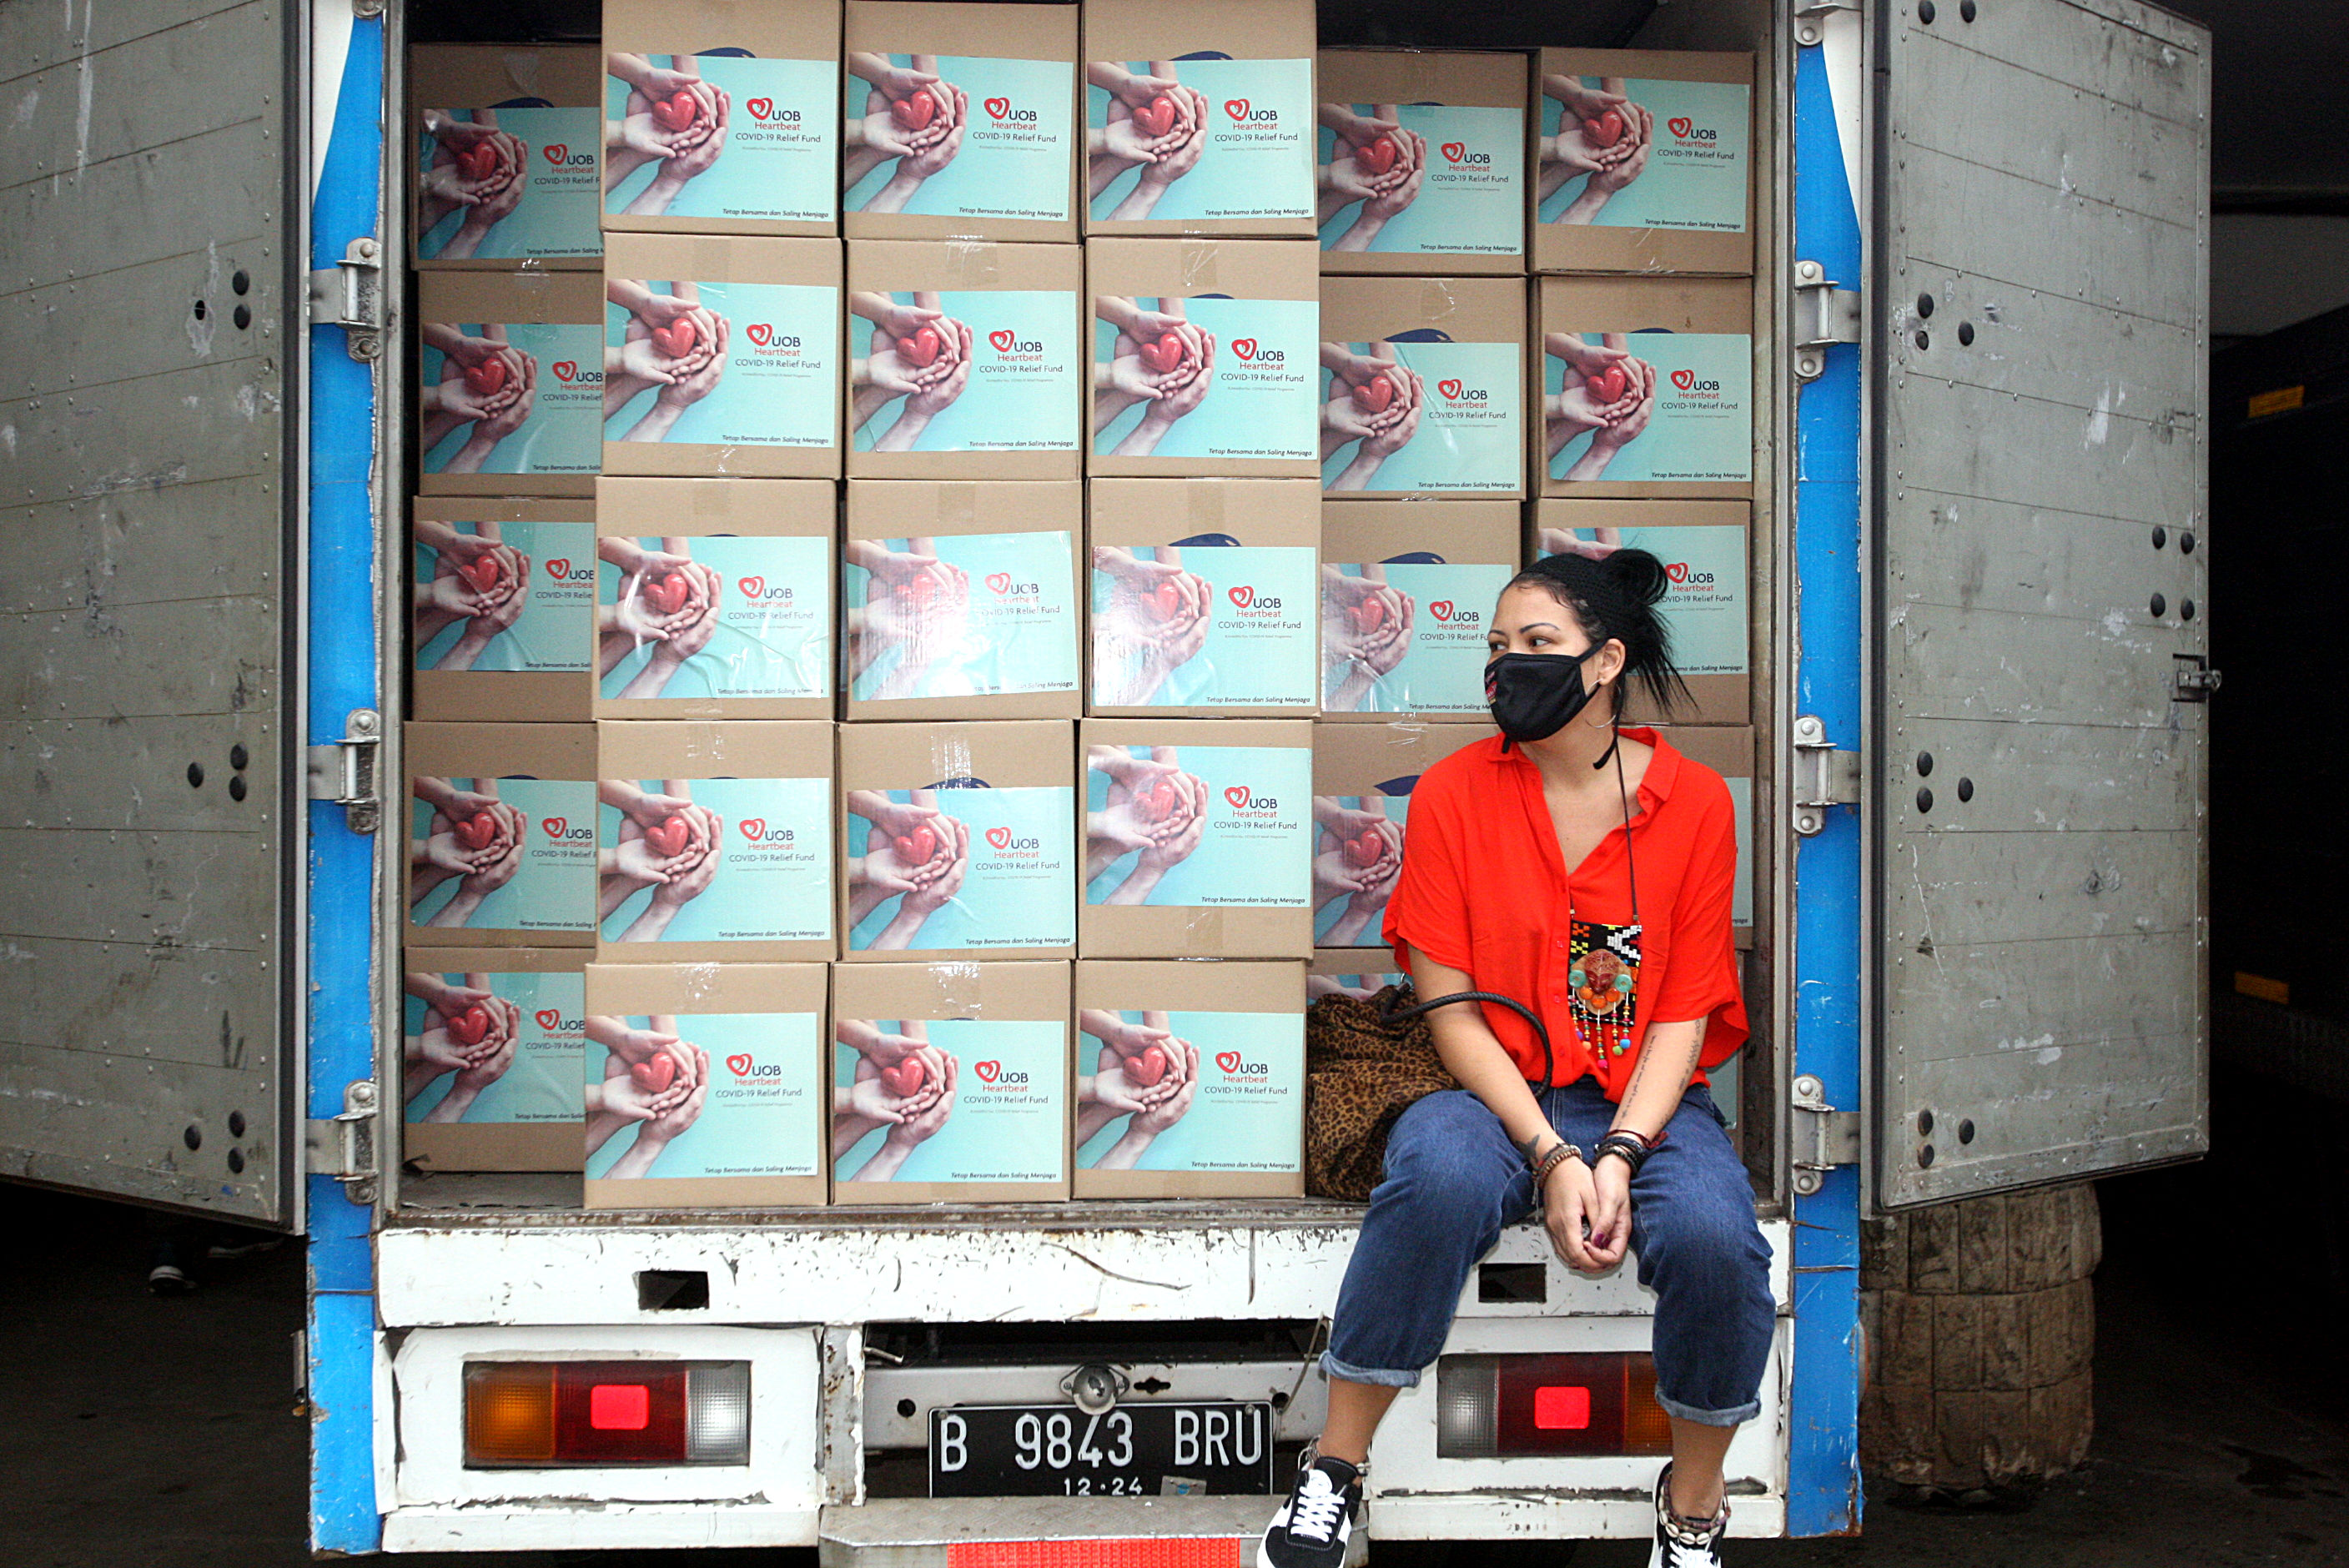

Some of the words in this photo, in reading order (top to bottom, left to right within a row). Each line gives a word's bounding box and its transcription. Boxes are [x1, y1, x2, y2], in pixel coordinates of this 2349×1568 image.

[772, 110, 801, 122] UOB
[1009, 109, 1037, 122] UOB
[1250, 110, 1277, 121] UOB
[755, 121, 800, 131] Heartbeat
[992, 120, 1036, 131] Heartbeat
[736, 133, 774, 141] COVID-19
[777, 133, 799, 142] Relief
[802, 134, 821, 143] Fund
[973, 132, 1010, 141] COVID-19
[1013, 133, 1035, 142] Relief
[1037, 134, 1056, 143] Fund
[1691, 128, 1717, 140] UOB
[1675, 138, 1716, 148] Heartbeat
[1464, 153, 1491, 163] UOB
[1657, 149, 1693, 158] COVID-19
[567, 155, 594, 164] UOB
[1449, 163, 1490, 173] Heartbeat
[772, 335, 801, 347] UOB
[755, 347, 800, 357] Heartbeat
[1014, 342, 1043, 352] UOB
[1256, 350, 1285, 361] UOB
[736, 359, 774, 367] COVID-19
[777, 359, 799, 368] Relief
[802, 360, 821, 369] Fund
[1240, 361, 1284, 371] Heartbeat
[576, 372, 602, 382] UOB
[1221, 373, 1259, 381] COVID-19
[561, 383, 602, 391] Heartbeat
[1693, 380, 1719, 390] UOB
[1461, 389, 1487, 400] UOB
[1678, 391, 1719, 400] Heartbeat
[1446, 400, 1487, 409] Heartbeat
[1688, 573, 1714, 583] UOB
[554, 580, 594, 589] Heartbea
[1010, 583, 1039, 595] UOB
[764, 588, 792, 599] UOB
[1253, 598, 1281, 608] UOB
[1237, 610, 1281, 618] Heartbeat
[1453, 611, 1479, 621] UOB
[1437, 622, 1479, 631] Heartbeat
[1250, 798, 1278, 809] UOB
[1233, 809, 1277, 818] Heartbeat
[1214, 821, 1251, 829] COVID-19
[566, 828, 592, 839] UOB
[765, 830, 794, 841] UOB
[550, 839, 591, 848] Heartbeat
[1011, 838, 1039, 849] UOB
[531, 850, 567, 858] COVID-19
[752, 1065, 782, 1076] UOB
[1240, 1063, 1269, 1074] UOB
[735, 1078, 781, 1086] Heartbeat
[1000, 1073, 1029, 1083] UOB
[1224, 1074, 1268, 1083] Heartbeat
[983, 1084, 1028, 1093] Heartbeat
[1205, 1086, 1242, 1094] COVID-19
[941, 1414, 968, 1471] B
[1015, 1411, 1133, 1470] 9843
[1174, 1410, 1261, 1466] BRU
